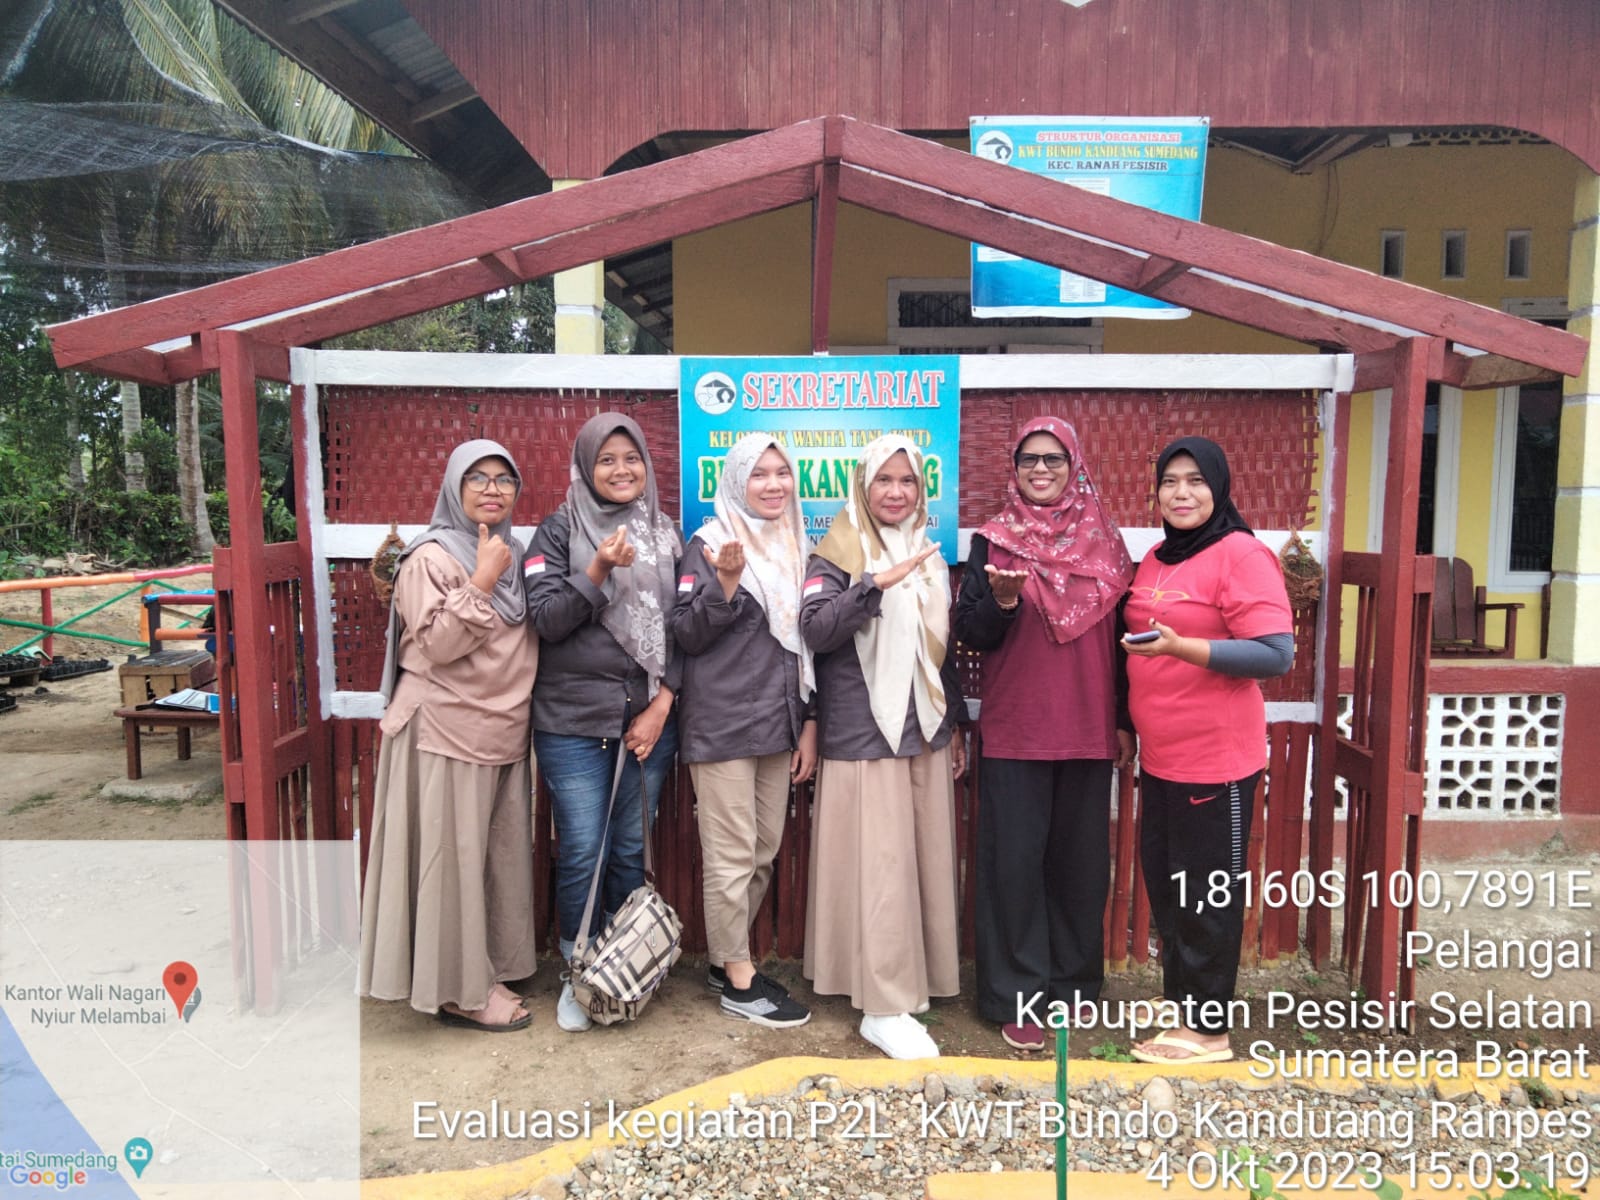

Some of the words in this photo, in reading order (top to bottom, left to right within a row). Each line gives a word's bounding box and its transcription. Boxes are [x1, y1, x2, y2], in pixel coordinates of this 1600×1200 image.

[1038, 132, 1101, 142] STRUKTUR
[1105, 132, 1181, 142] ORGANISASI
[1018, 145, 1042, 159] KWT
[1046, 145, 1082, 158] BUNDO
[1085, 145, 1141, 159] KANDUANG
[1144, 145, 1198, 159] SUMEDANG
[1047, 161, 1074, 170] KEC.
[1077, 161, 1120, 170] RANAH
[1123, 161, 1168, 171] PESISIR
[743, 371, 944, 408] SEKRETARIAT
[792, 430, 846, 447] WANITA
